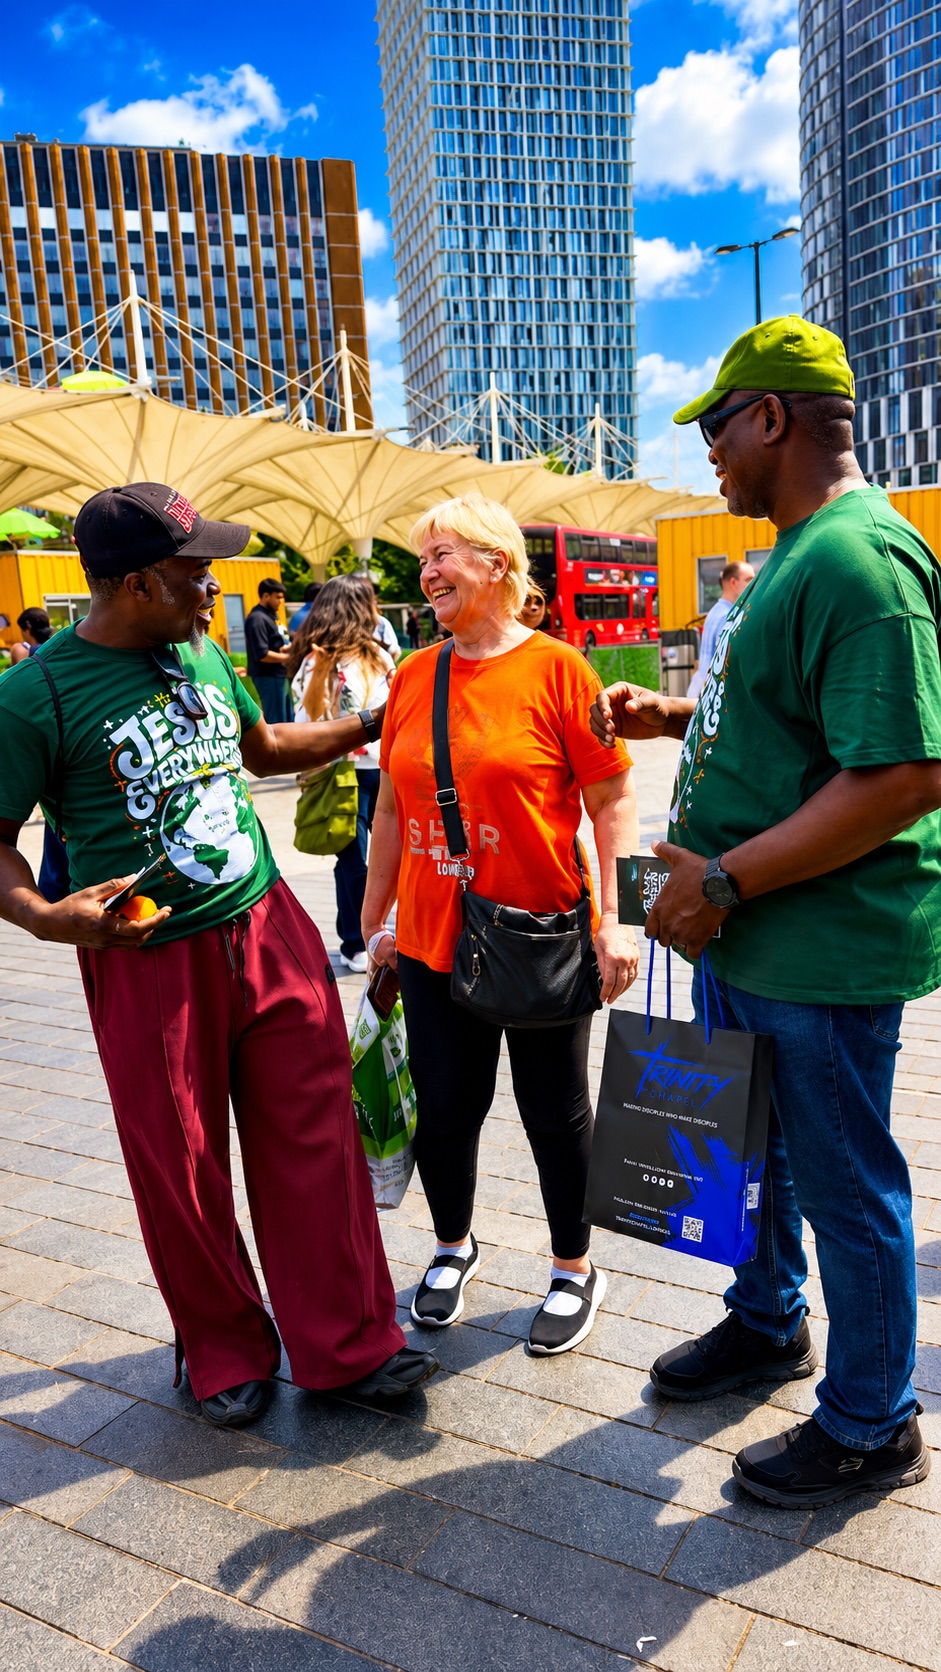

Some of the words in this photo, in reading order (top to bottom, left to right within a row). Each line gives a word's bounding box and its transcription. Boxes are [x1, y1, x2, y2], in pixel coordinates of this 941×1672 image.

[109, 682, 237, 780] JESUS
[628, 1036, 738, 1110] TRINITY
[650, 1089, 696, 1108] CHAPEL
